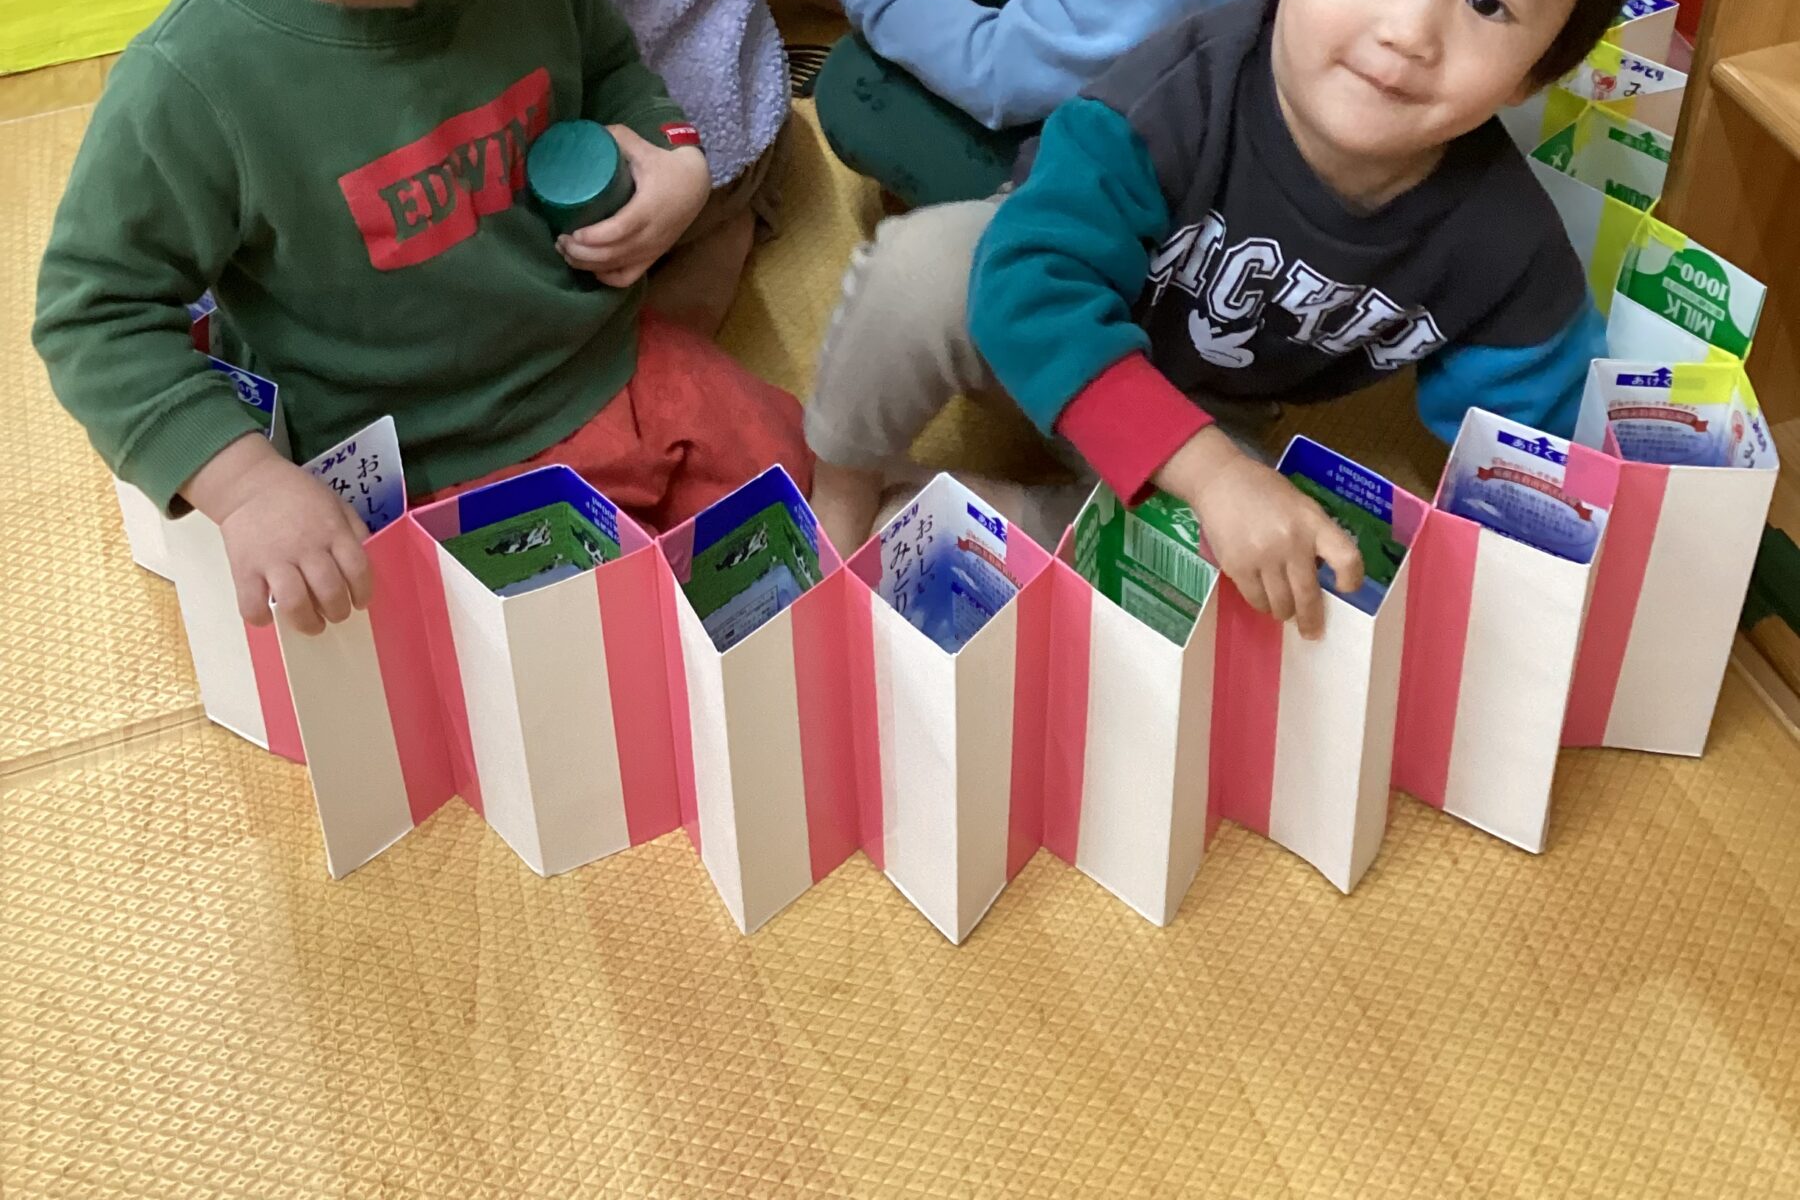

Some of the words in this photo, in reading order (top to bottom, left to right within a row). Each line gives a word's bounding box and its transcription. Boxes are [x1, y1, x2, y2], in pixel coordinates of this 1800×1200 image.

[1664, 292, 1716, 341] MILK
[1631, 376, 1673, 387] あけく
[916, 514, 936, 594] おいしい
